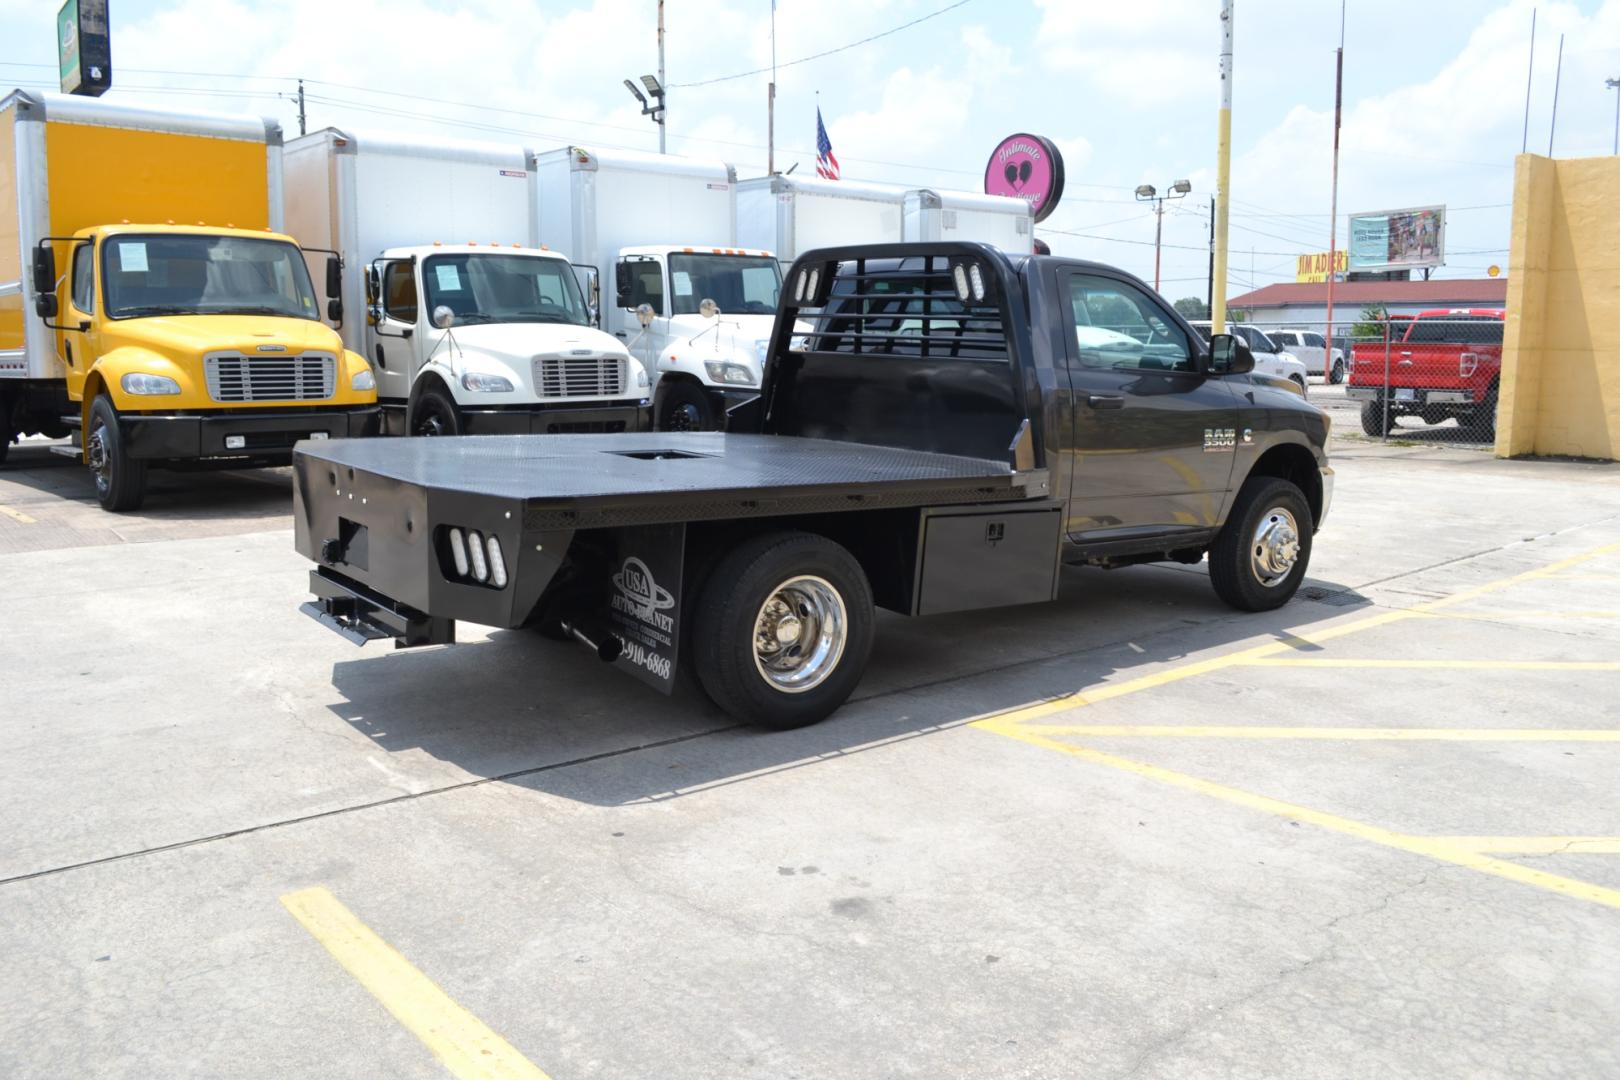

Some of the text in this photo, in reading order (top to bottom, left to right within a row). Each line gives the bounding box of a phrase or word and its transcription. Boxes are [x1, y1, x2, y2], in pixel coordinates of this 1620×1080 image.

[999, 142, 1041, 162] Intimate
[1298, 255, 1313, 274] JIM
[1204, 429, 1236, 438] RAM
[625, 569, 649, 596] USA
